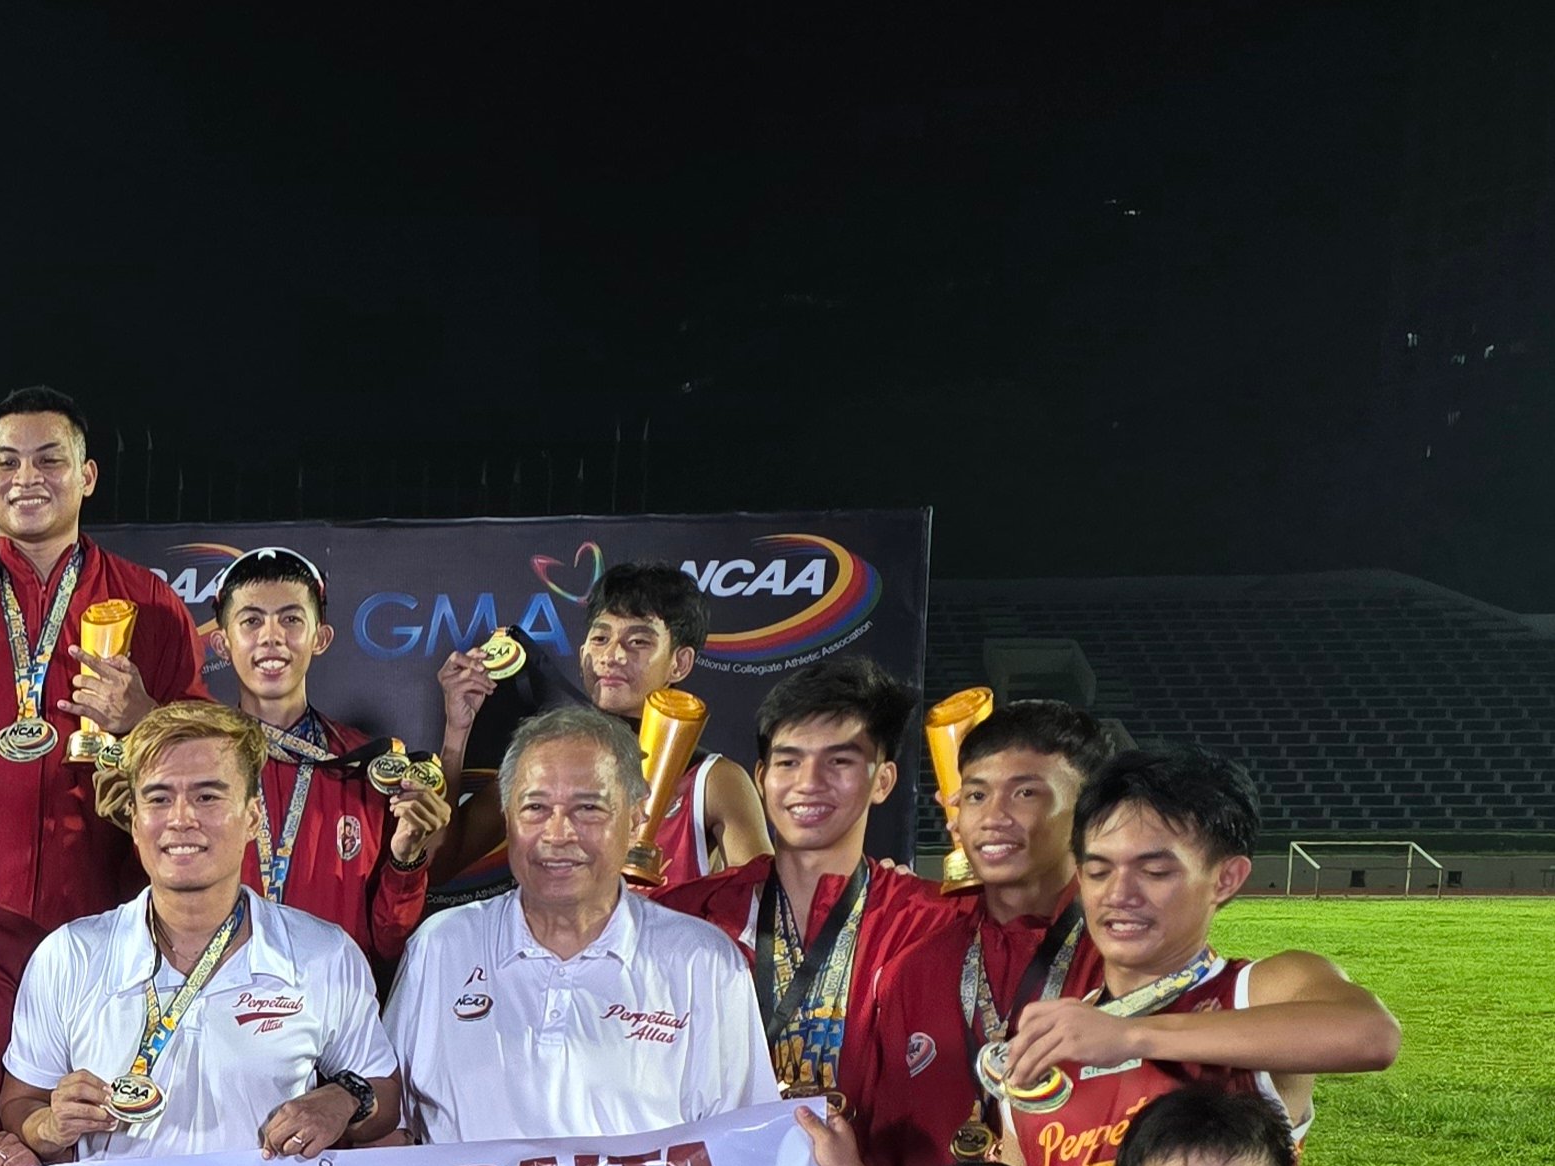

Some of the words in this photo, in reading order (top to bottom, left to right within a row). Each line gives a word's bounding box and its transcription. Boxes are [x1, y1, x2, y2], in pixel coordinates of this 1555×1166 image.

[680, 559, 827, 596] NCAA
[353, 592, 571, 661] GMA
[732, 661, 783, 676] Collegiate
[784, 652, 821, 670] Athletic
[821, 620, 873, 657] Association
[202, 660, 231, 675] thletic
[9, 724, 43, 736] NCAA
[232, 992, 304, 1012] Perpetual
[599, 1004, 691, 1030] Perpetual
[253, 1019, 284, 1036] Altas
[110, 1082, 150, 1100] NCAA
